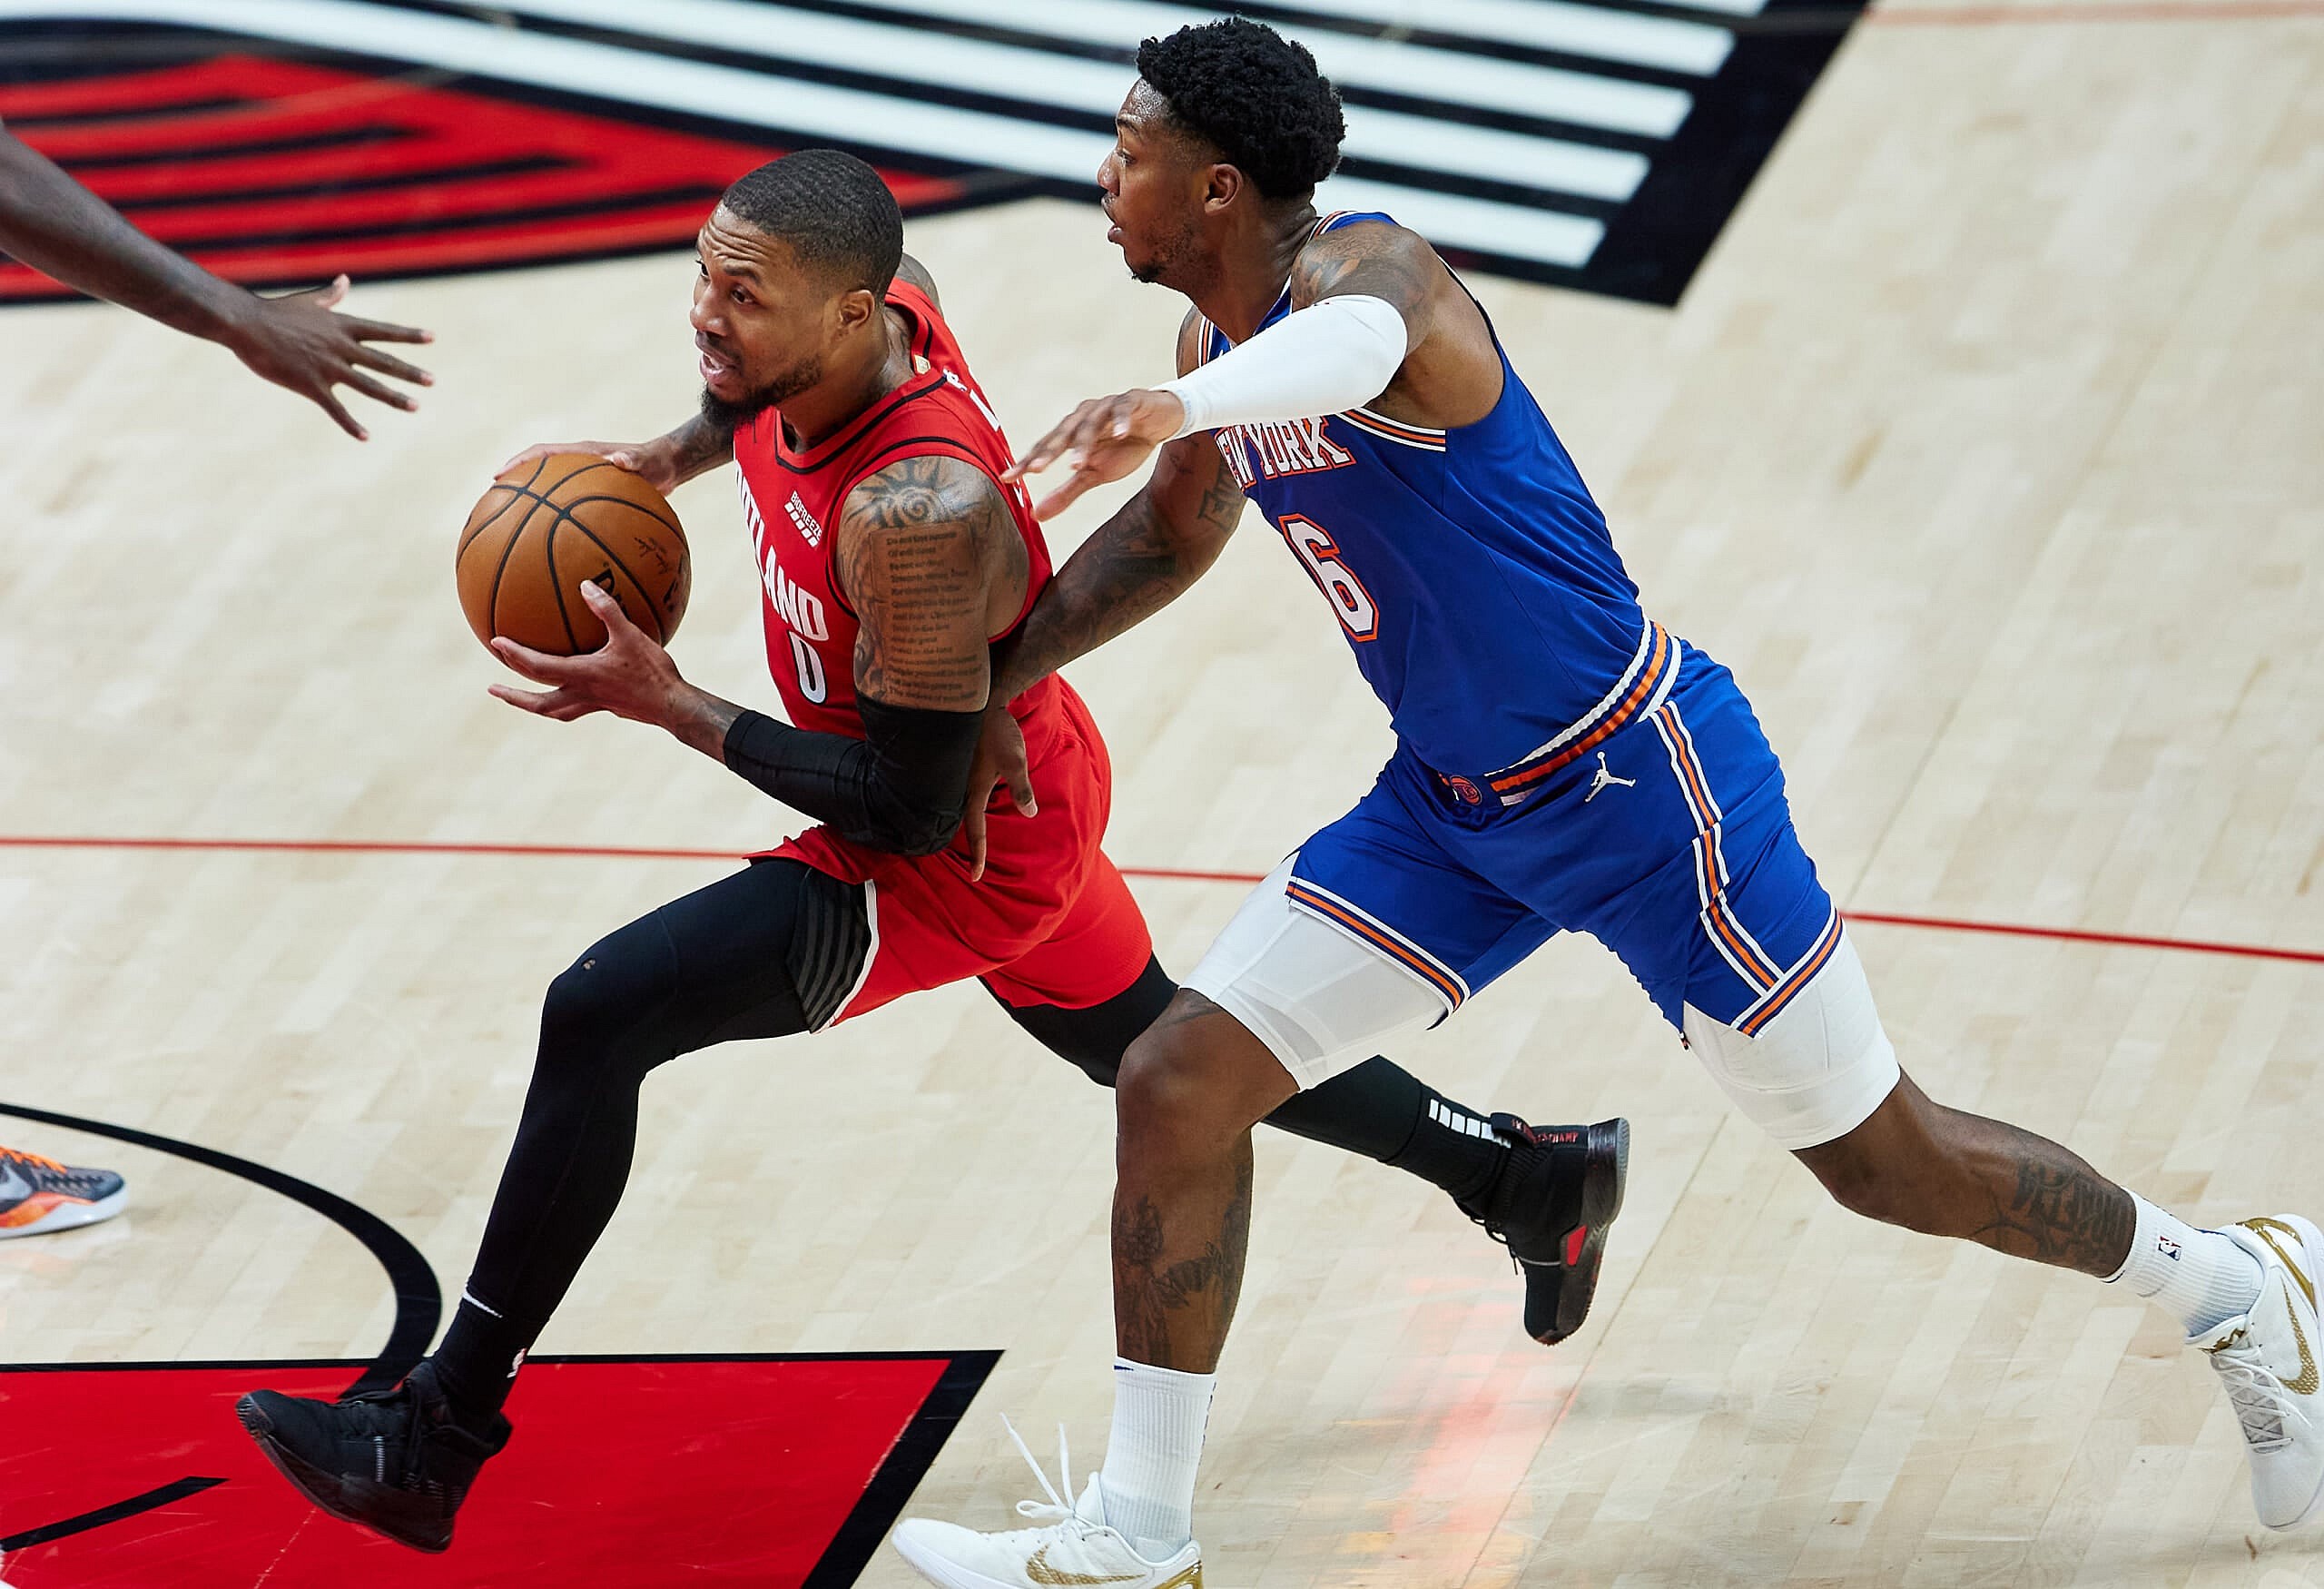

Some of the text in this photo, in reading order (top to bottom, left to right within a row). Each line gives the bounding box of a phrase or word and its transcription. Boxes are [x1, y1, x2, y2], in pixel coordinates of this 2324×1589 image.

[1214, 416, 1357, 493] EW YORK
[734, 459, 830, 641] ORTLAND
[1277, 513, 1380, 643] 6
[787, 628, 828, 706] 0
